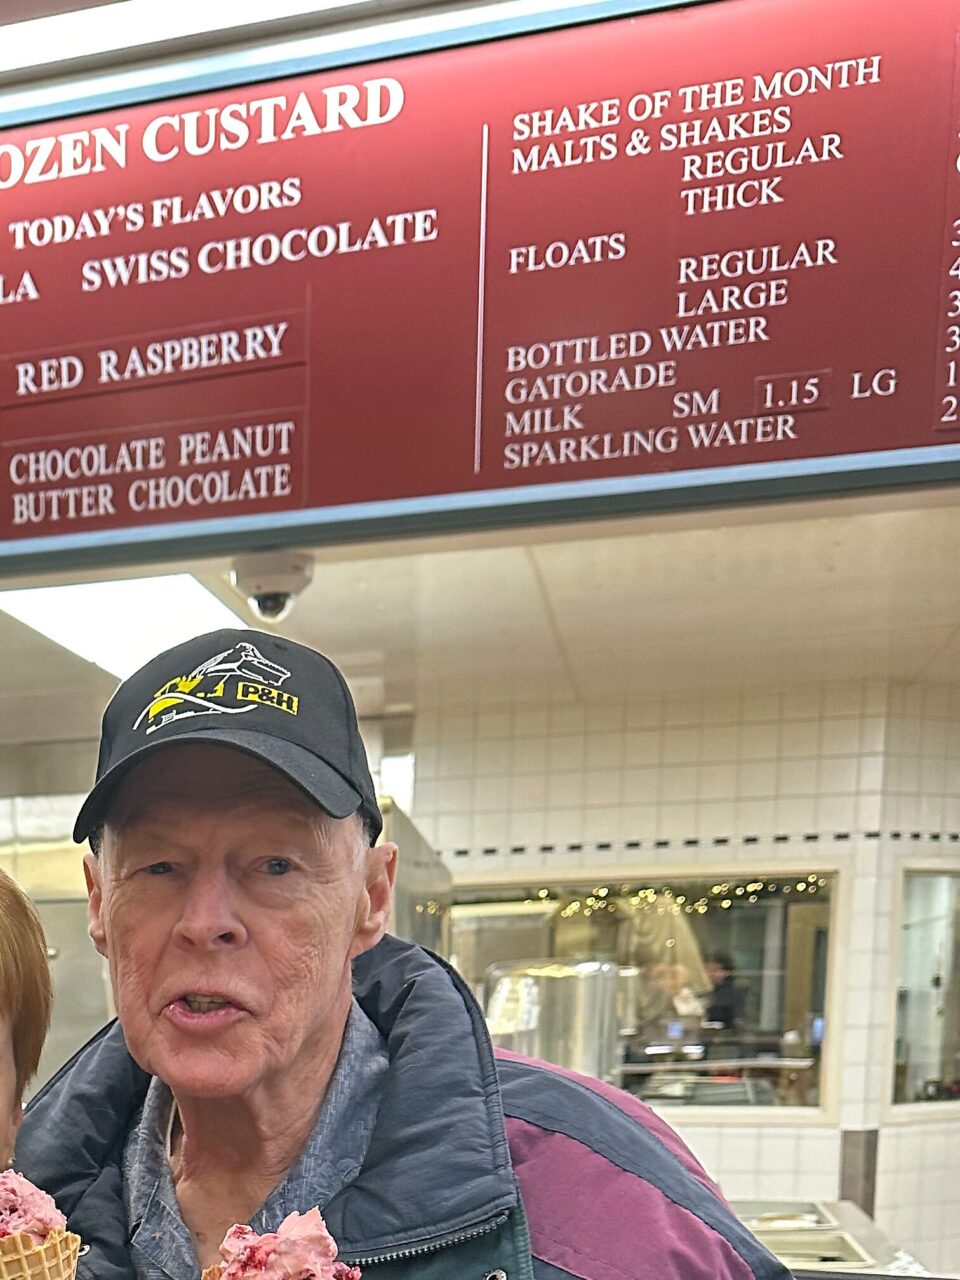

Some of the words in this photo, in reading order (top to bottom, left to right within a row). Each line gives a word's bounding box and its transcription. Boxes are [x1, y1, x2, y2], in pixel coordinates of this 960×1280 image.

[143, 78, 404, 162] CUSTARD
[513, 99, 620, 141] SHAKE
[628, 90, 671, 121] OF
[679, 79, 744, 113] THE
[752, 56, 881, 102] MONTH
[511, 133, 617, 174] MALTS
[625, 129, 651, 156] &
[660, 106, 790, 151] SHAKES
[681, 134, 844, 182] REGULAR
[151, 177, 301, 227] FLAVORS
[680, 176, 784, 215] THICK
[82, 247, 189, 292] SWISS
[198, 209, 438, 274] CHOCOLATE
[508, 233, 625, 274] FLOATS
[677, 239, 838, 284] REGULAR
[676, 279, 788, 318] LARGE
[15, 356, 83, 396] RED
[97, 322, 288, 384] RASPBERRY
[506, 331, 651, 372] BOTTLED
[658, 317, 770, 352] WATER
[505, 360, 677, 404] GATORADE
[505, 404, 584, 437] MILK
[673, 388, 720, 418] SM
[762, 379, 820, 409] 1.15
[850, 369, 896, 399] LG
[9, 437, 166, 485] CHOCOLATE
[178, 421, 295, 466] PEANUT
[504, 427, 678, 469] SPARKLING
[687, 415, 798, 449] WATER
[12, 484, 115, 524] BUTTER
[128, 463, 292, 511] CHOCOLATE
[242, 684, 294, 711] P&H
